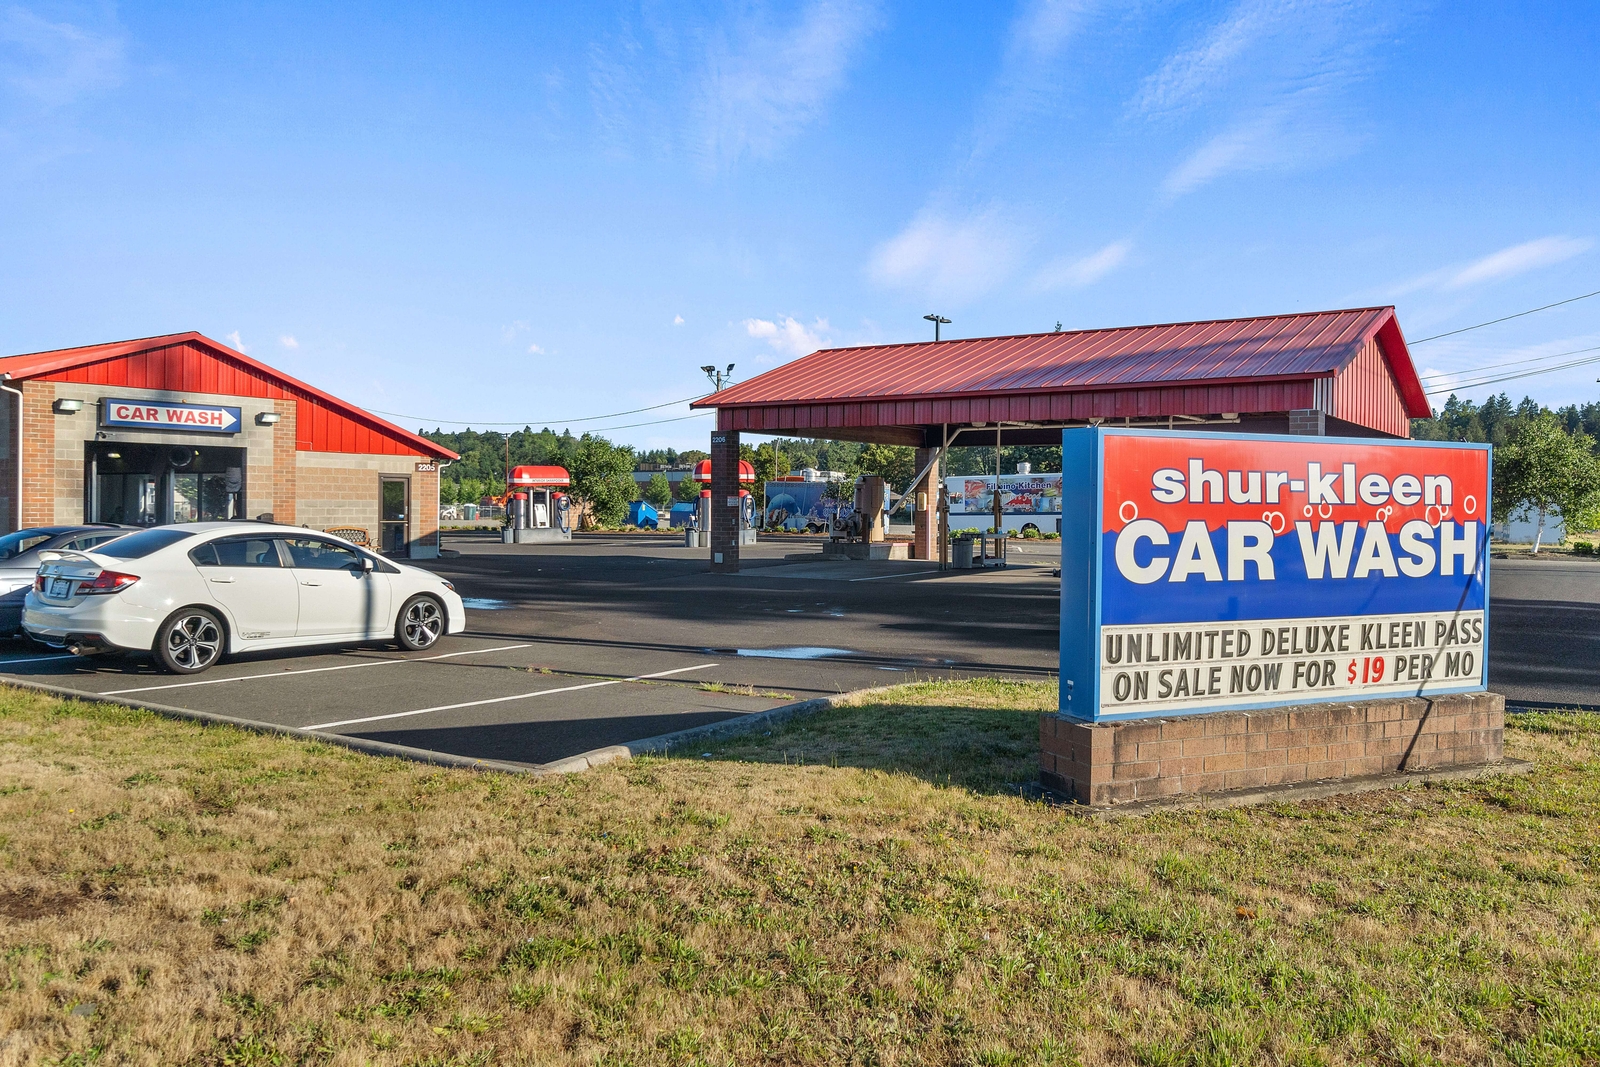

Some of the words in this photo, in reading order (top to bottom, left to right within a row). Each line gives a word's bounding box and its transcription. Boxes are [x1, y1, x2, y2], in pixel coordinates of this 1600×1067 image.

[116, 406, 159, 421] CAR
[166, 409, 223, 425] WASH
[1017, 481, 1052, 490] Kitchen
[1151, 457, 1453, 506] shur-kleen
[1115, 518, 1276, 584] CAR
[1294, 518, 1477, 580] WASH
[1106, 629, 1251, 665] UNLIMITED
[1261, 624, 1350, 656] DELUXE
[1360, 620, 1426, 651] KLEEN
[1434, 617, 1482, 646] PASS
[1113, 671, 1149, 701] ON
[1158, 665, 1222, 698] SALE
[1229, 662, 1283, 692] NOW
[1292, 659, 1336, 688] FOR
[1347, 656, 1385, 684] $19
[1393, 653, 1433, 682] PER
[1444, 650, 1474, 678] MO
